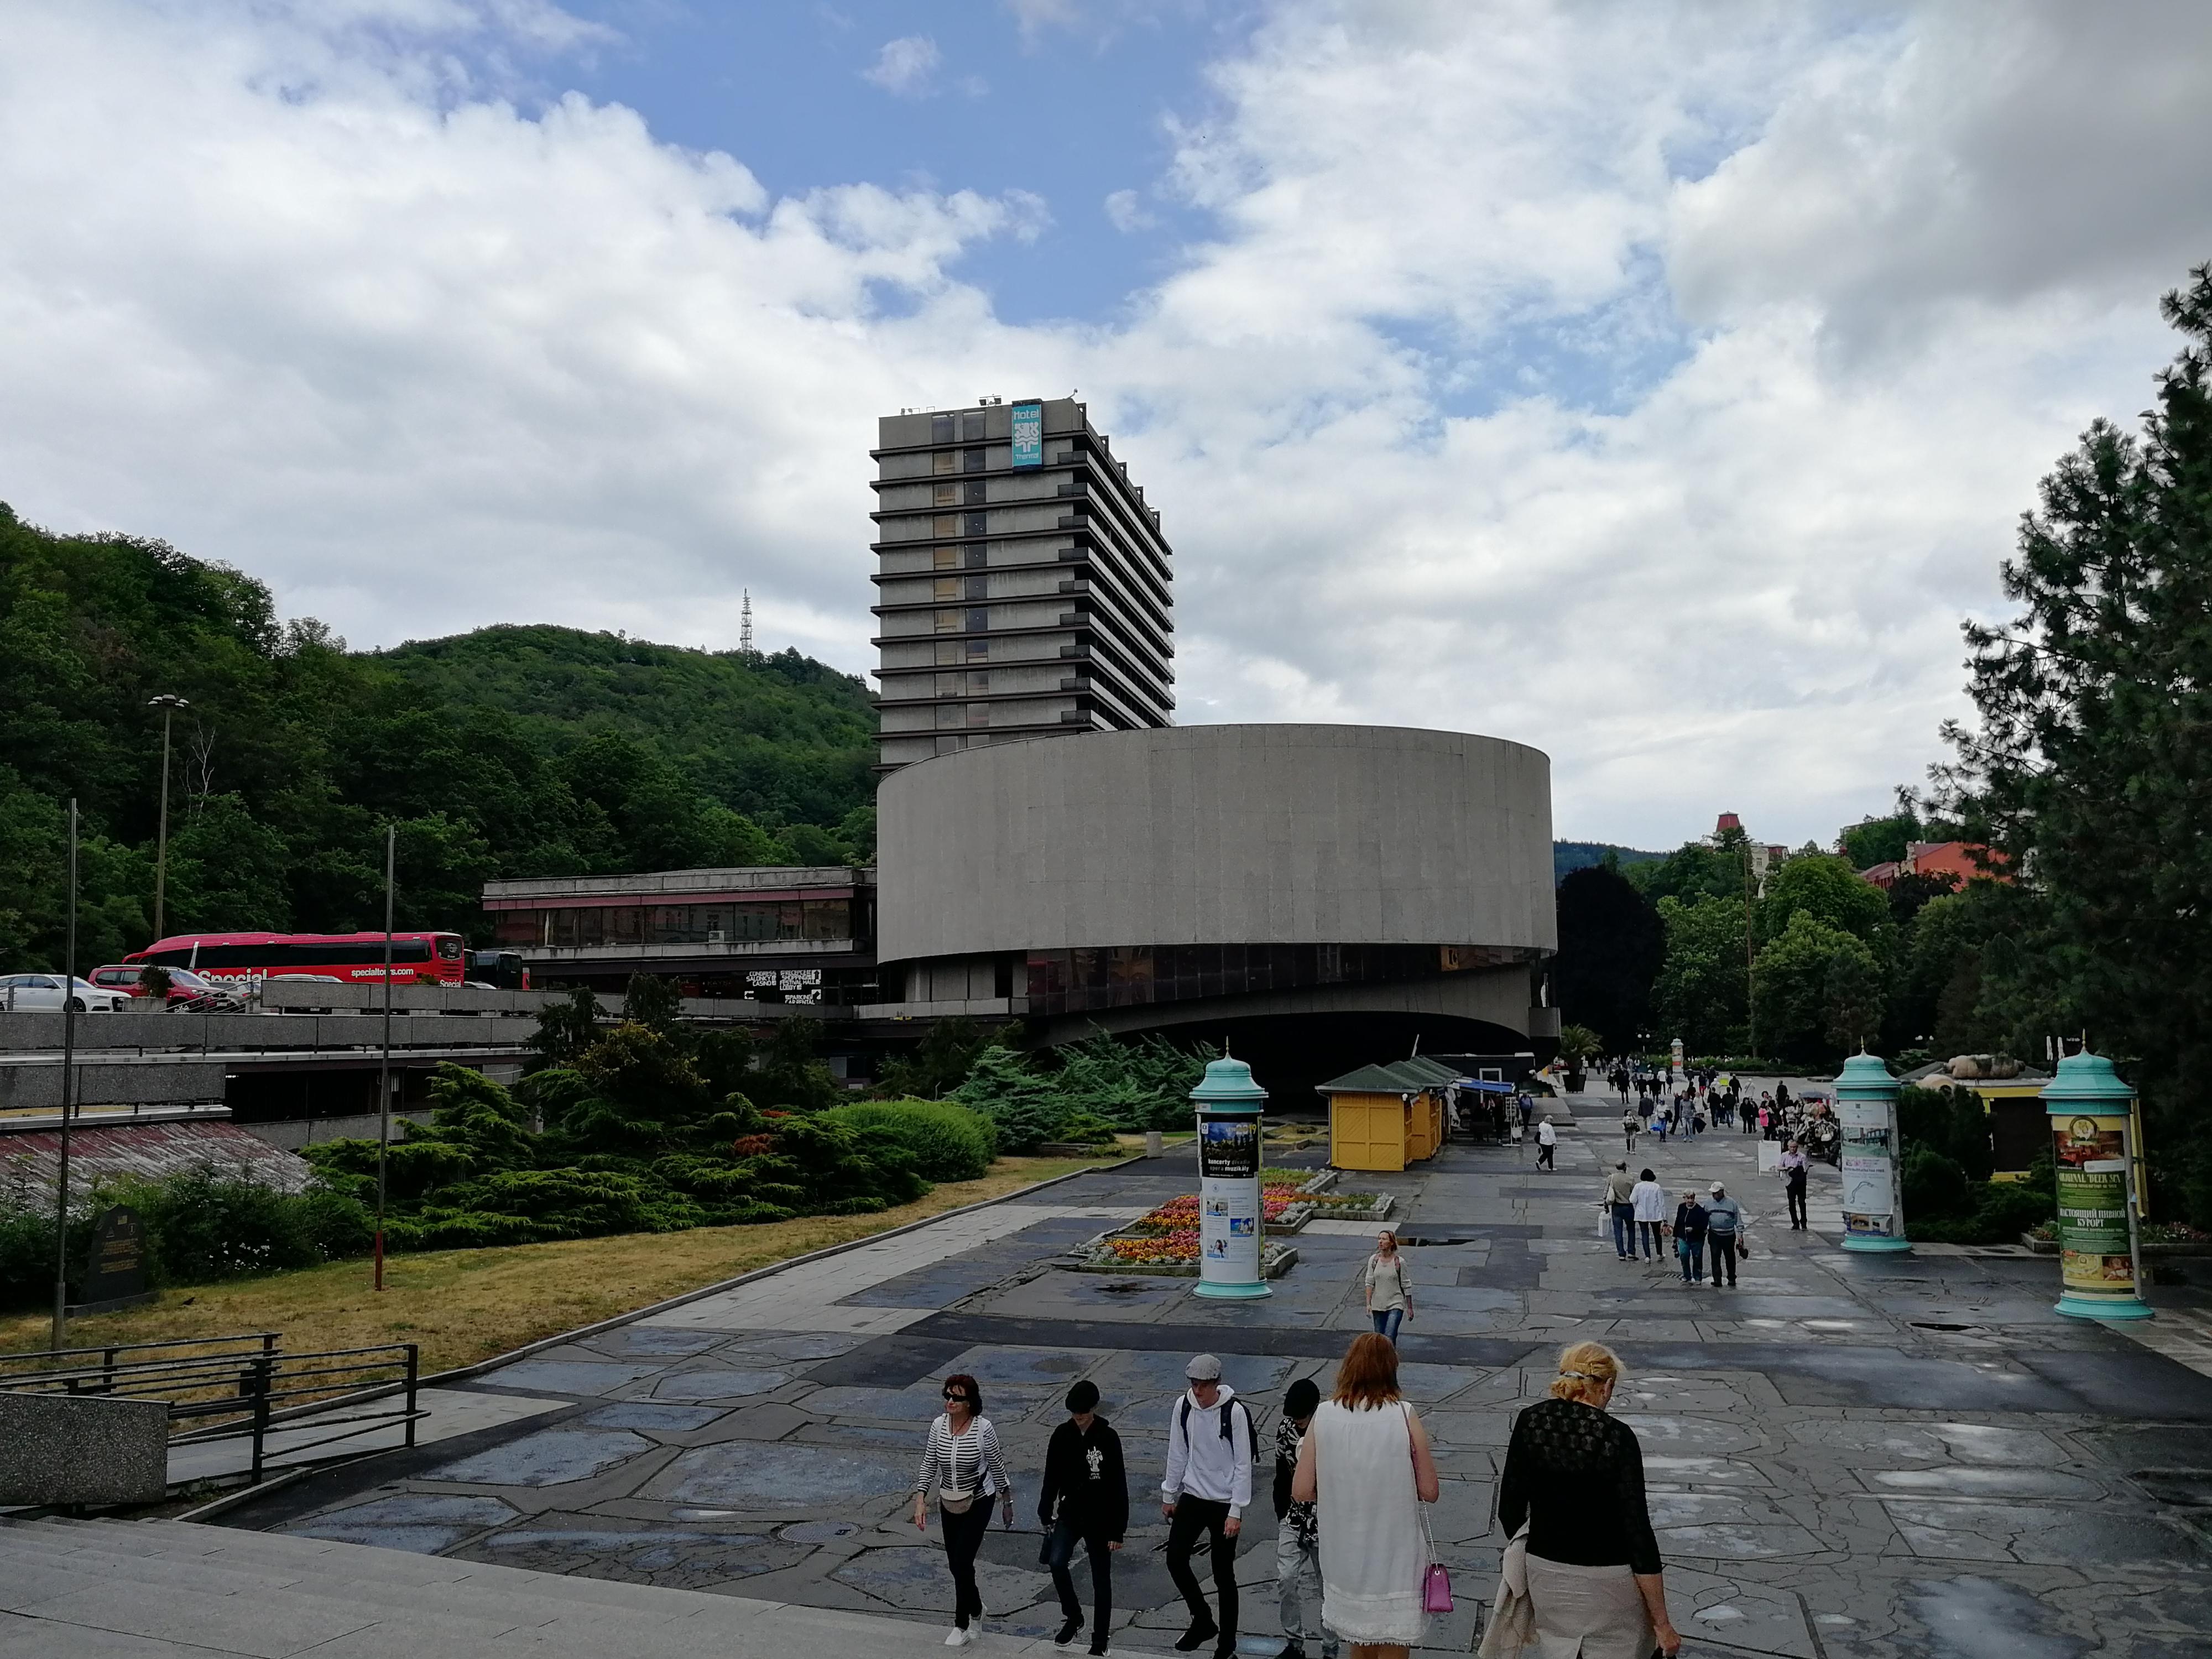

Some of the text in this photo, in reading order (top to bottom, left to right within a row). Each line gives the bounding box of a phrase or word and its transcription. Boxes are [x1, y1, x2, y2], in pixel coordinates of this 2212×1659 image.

[1014, 409, 1039, 420] Hotel
[1208, 1158, 1230, 1166] koncerty
[2059, 1172, 2086, 1183] ORIGINAL
[2088, 1173, 2108, 1183] BEER
[2077, 1218, 2104, 1227] КУРОРТ
